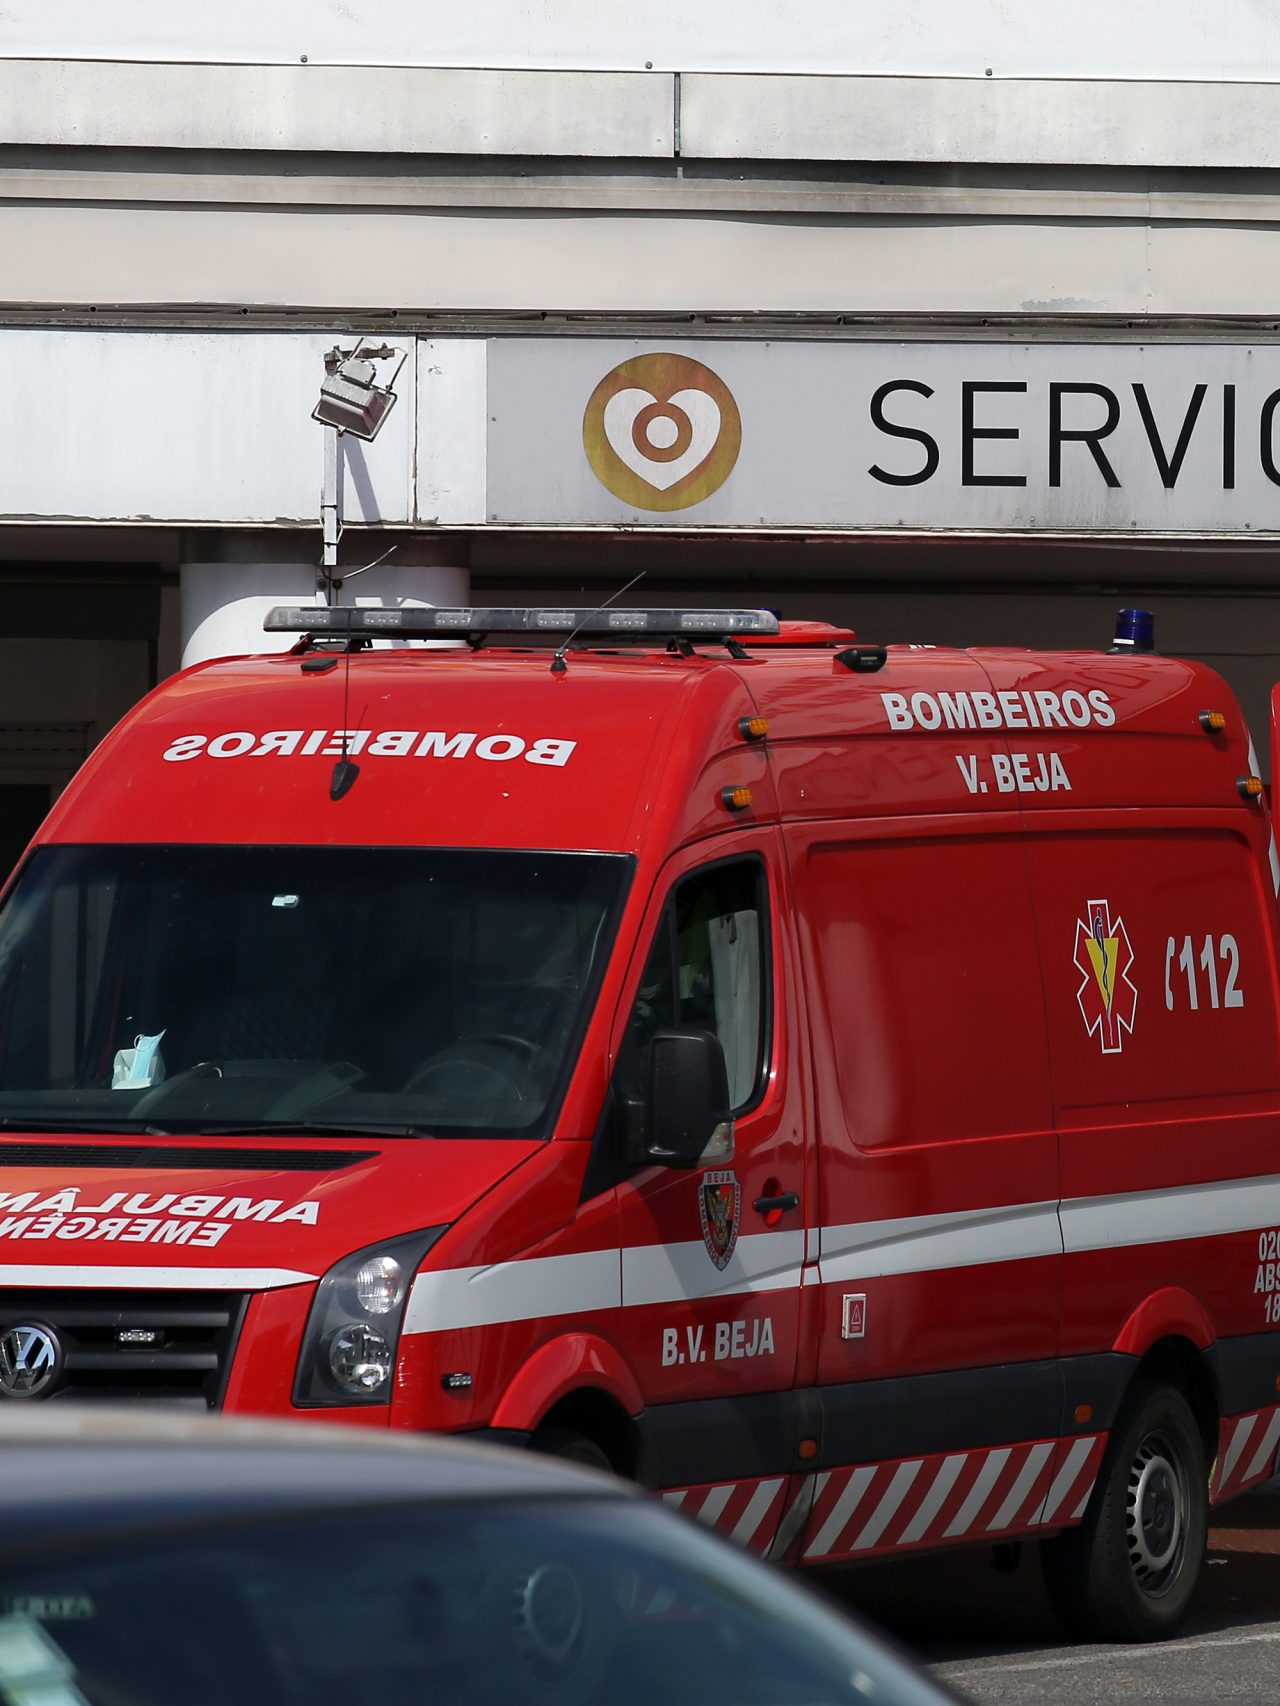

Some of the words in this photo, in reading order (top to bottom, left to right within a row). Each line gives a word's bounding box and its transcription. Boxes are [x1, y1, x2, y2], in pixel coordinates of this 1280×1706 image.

[880, 689, 1116, 731] BOMBEIROS
[954, 754, 988, 794] V.
[991, 752, 1072, 793] BEJA
[1179, 933, 1245, 1010] 112
[707, 1171, 731, 1184] BEJA
[661, 1324, 707, 1367] B.V.
[713, 1317, 775, 1361] BEJA
